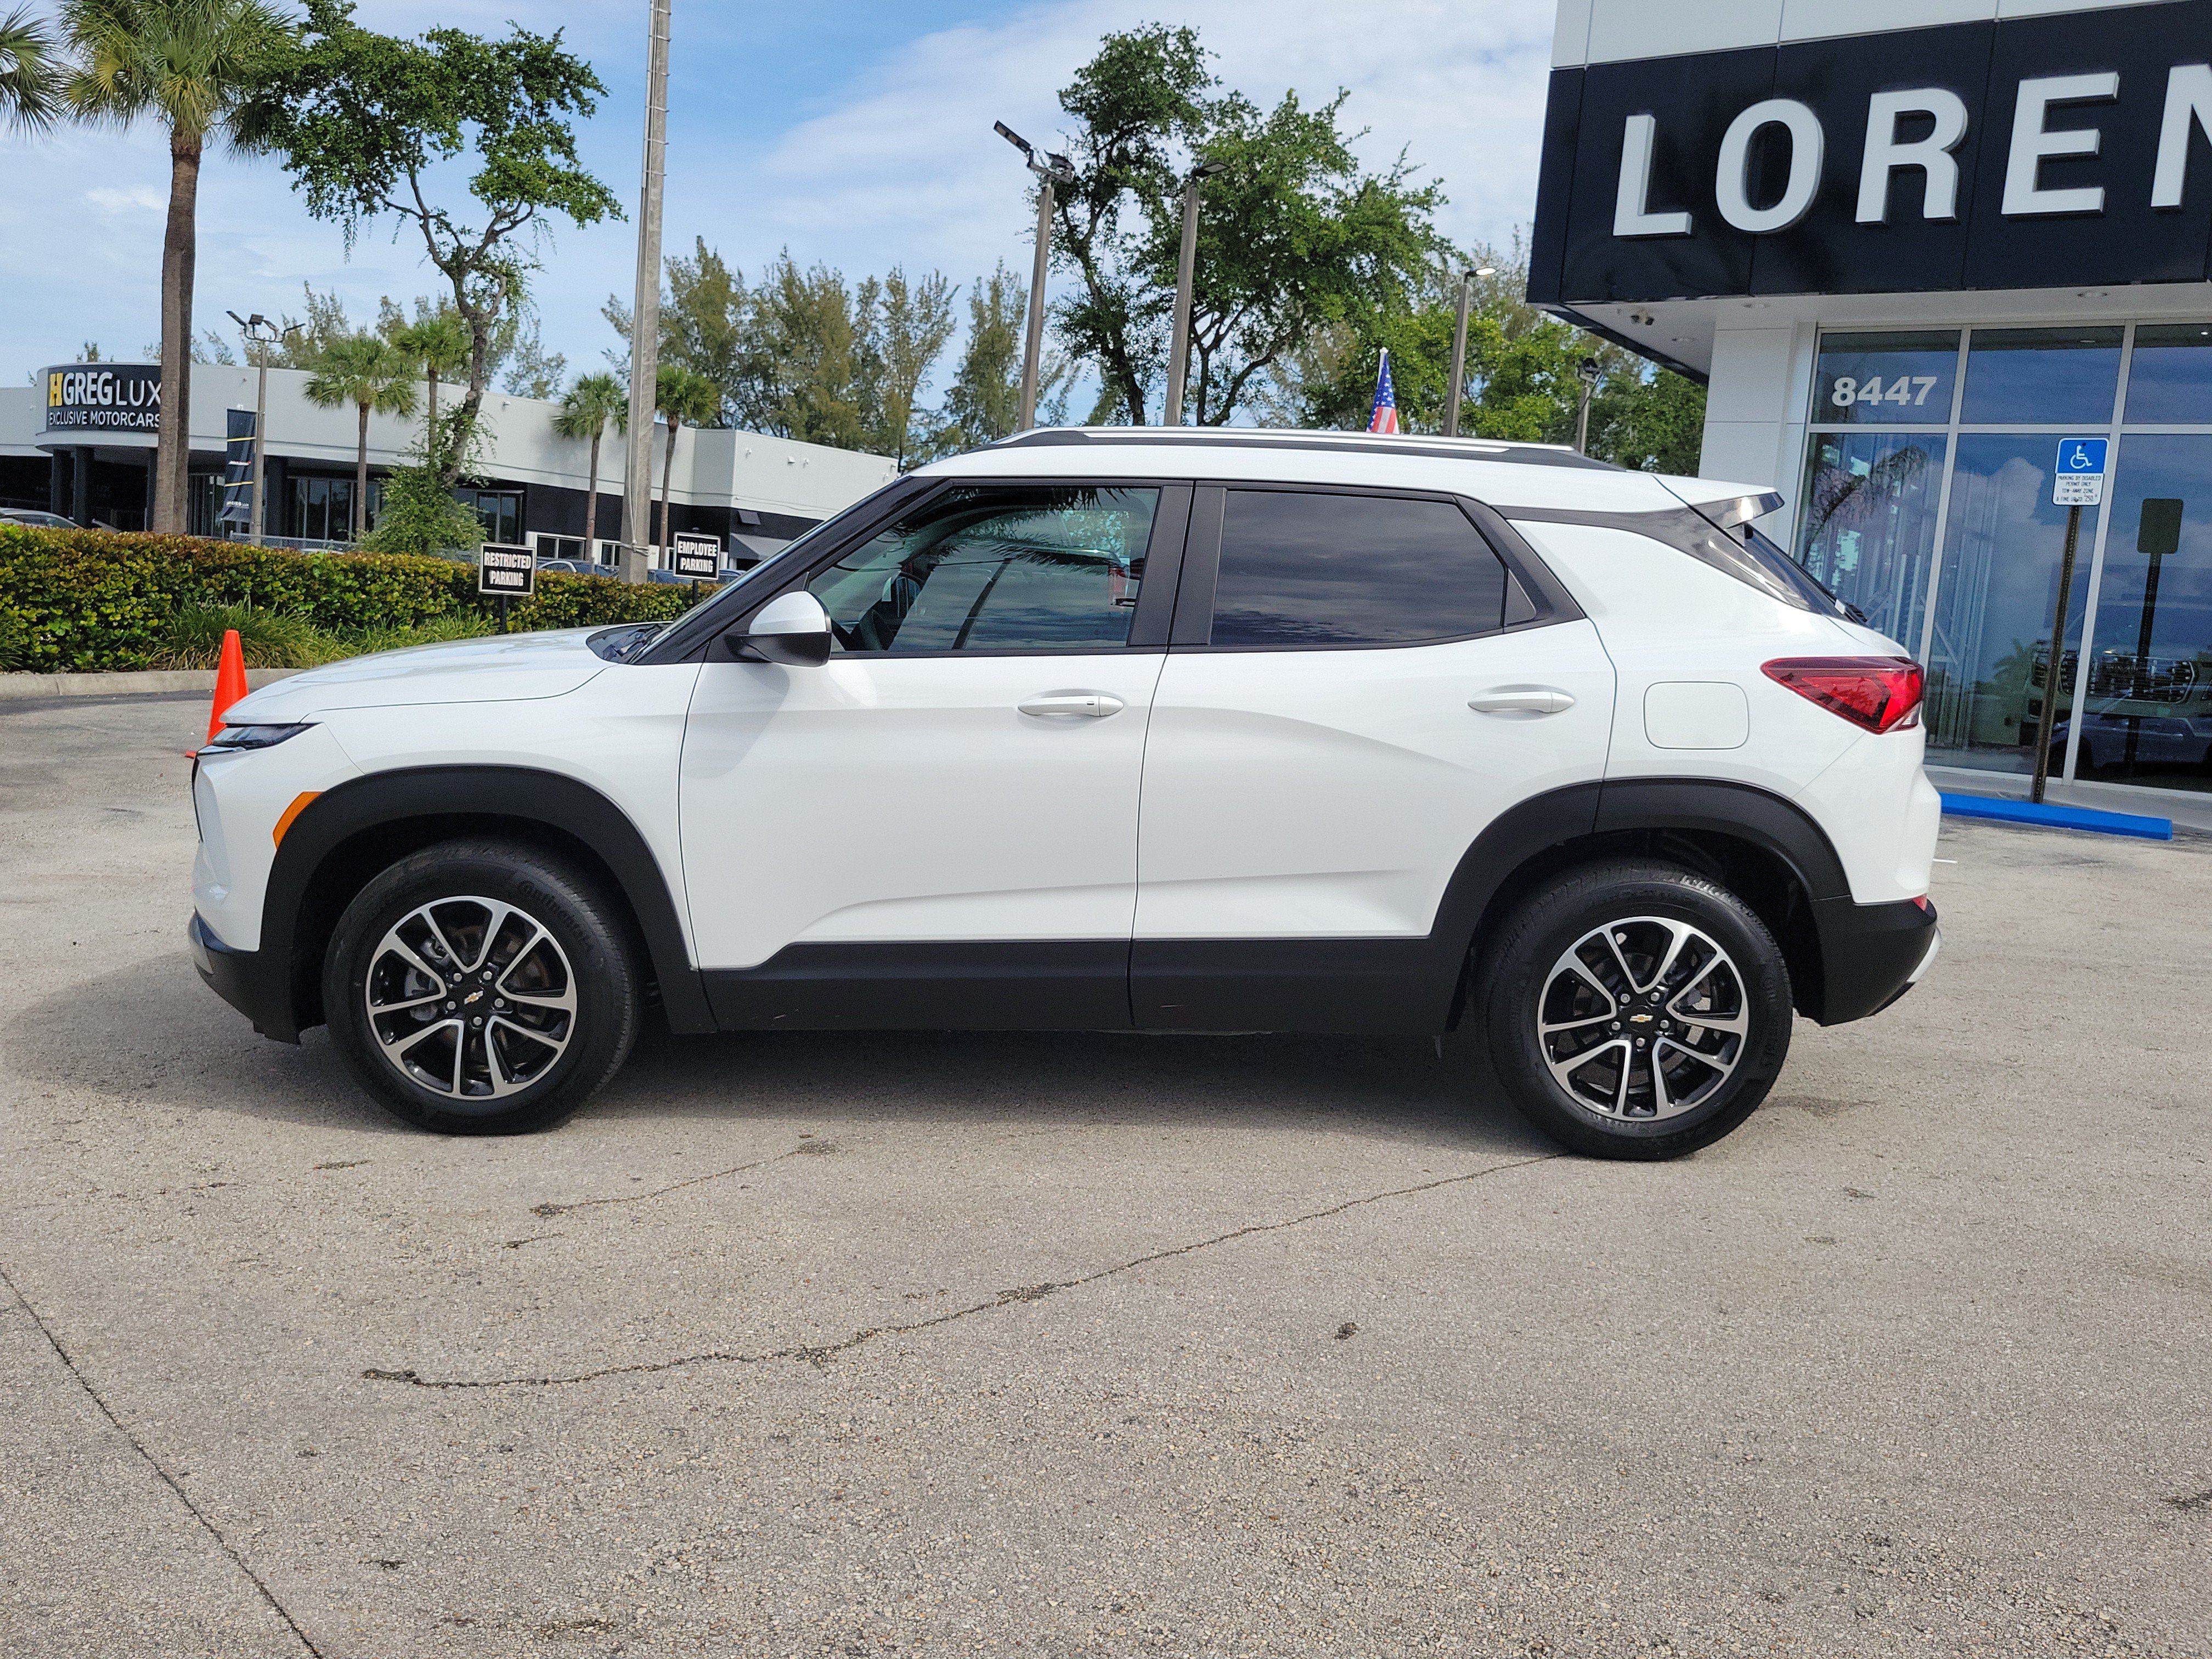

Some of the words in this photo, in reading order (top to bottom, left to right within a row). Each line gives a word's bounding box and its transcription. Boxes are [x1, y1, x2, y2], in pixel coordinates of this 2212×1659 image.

[1832, 376, 1937, 406] 8447
[49, 411, 87, 425] EXCLUSIVE
[90, 411, 160, 428] MOTORCARS
[678, 540, 717, 557] EMPLOYEE
[484, 551, 531, 569] RESTRICTED
[680, 557, 713, 573] PARKING
[489, 570, 524, 586] PARKING
